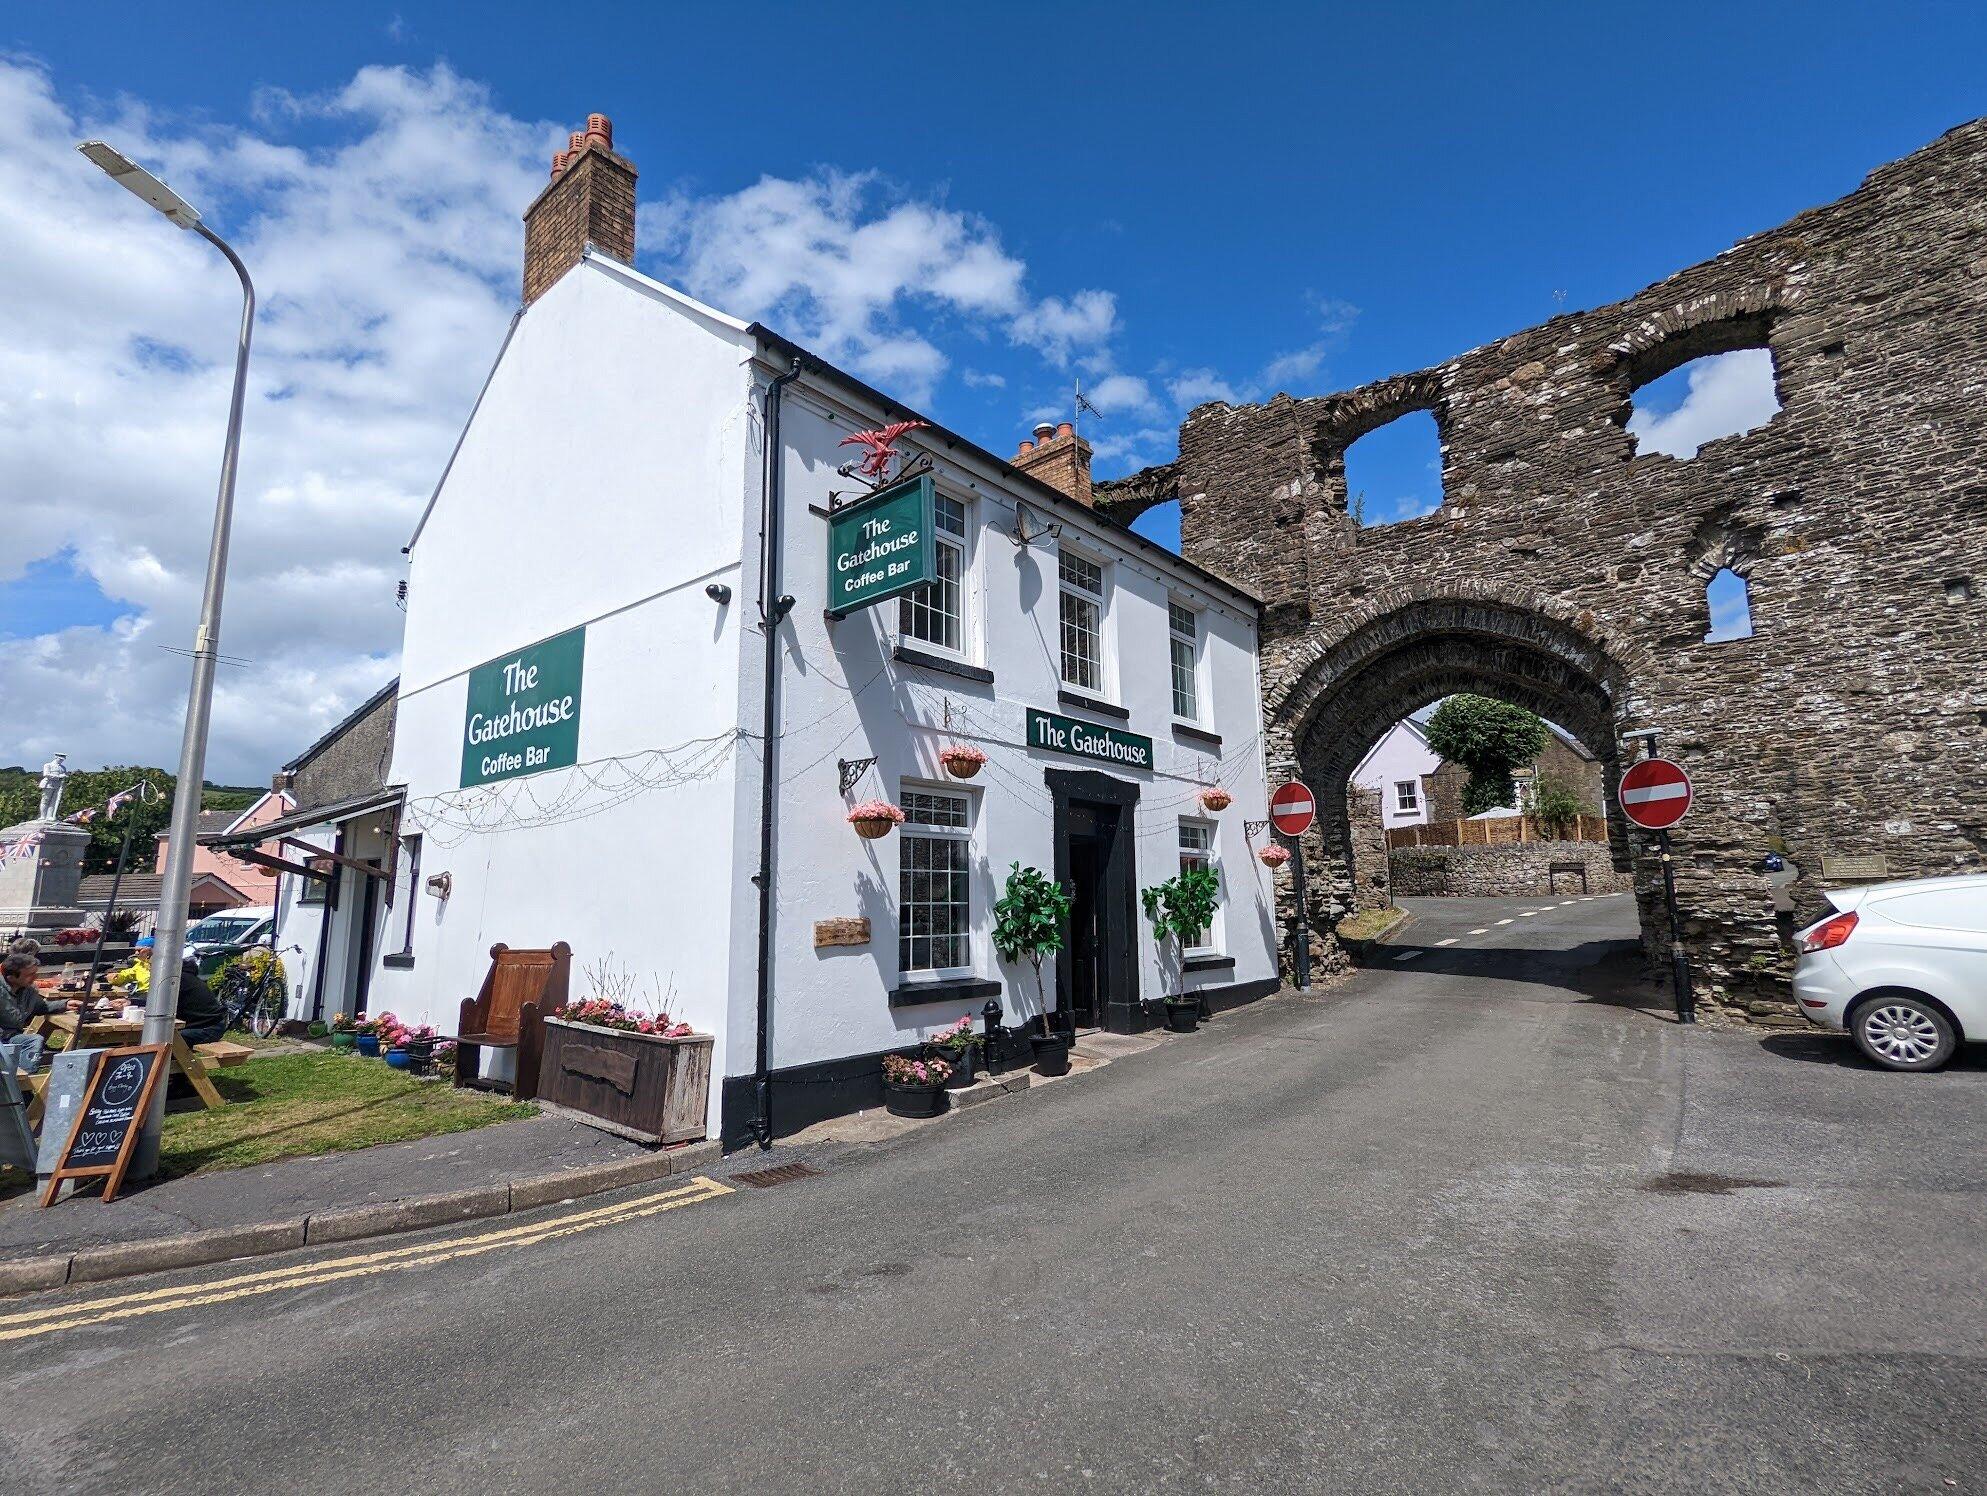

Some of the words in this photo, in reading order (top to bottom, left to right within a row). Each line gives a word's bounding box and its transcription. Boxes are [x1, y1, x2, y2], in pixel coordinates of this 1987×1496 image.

[862, 517, 892, 540] The
[837, 530, 919, 572] Gatehouse
[844, 570, 885, 592] Coffee
[887, 559, 911, 577] Bar
[503, 658, 539, 697] The
[468, 695, 575, 746] Gatehouse
[1035, 716, 1068, 748] The
[1070, 724, 1148, 765] Gatehouse
[481, 751, 523, 777] Coffee
[526, 745, 551, 767] Bar
